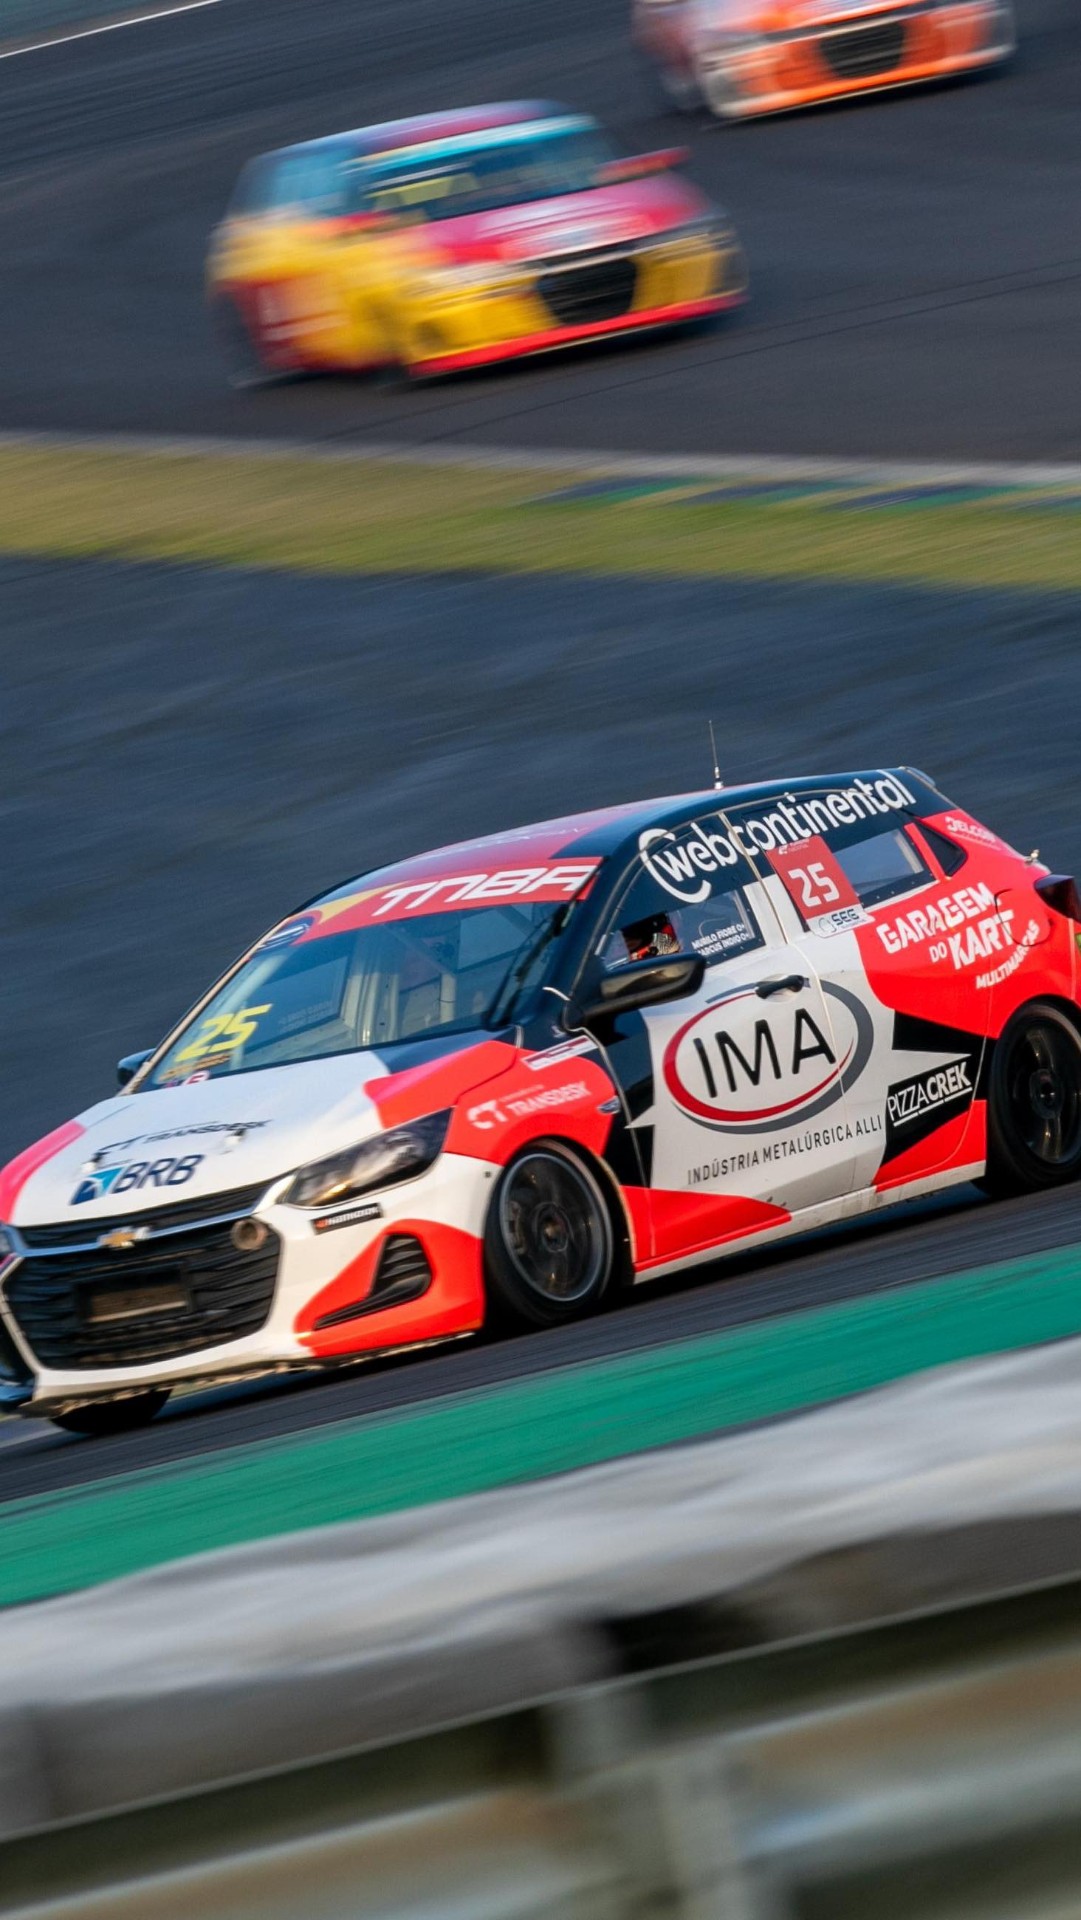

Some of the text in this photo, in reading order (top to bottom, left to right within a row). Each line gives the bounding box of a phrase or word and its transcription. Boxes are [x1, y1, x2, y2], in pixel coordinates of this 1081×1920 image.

[650, 778, 917, 886] webcontinental
[787, 863, 841, 908] 25
[876, 881, 1002, 954] GARAGEM
[928, 909, 1015, 970] DO KART
[174, 1003, 273, 1062] 25
[692, 1007, 837, 1099] IMA
[110, 1154, 206, 1195] BRB
[687, 1114, 883, 1186] INDÚSTRIA METALÚRGICA ALLI
